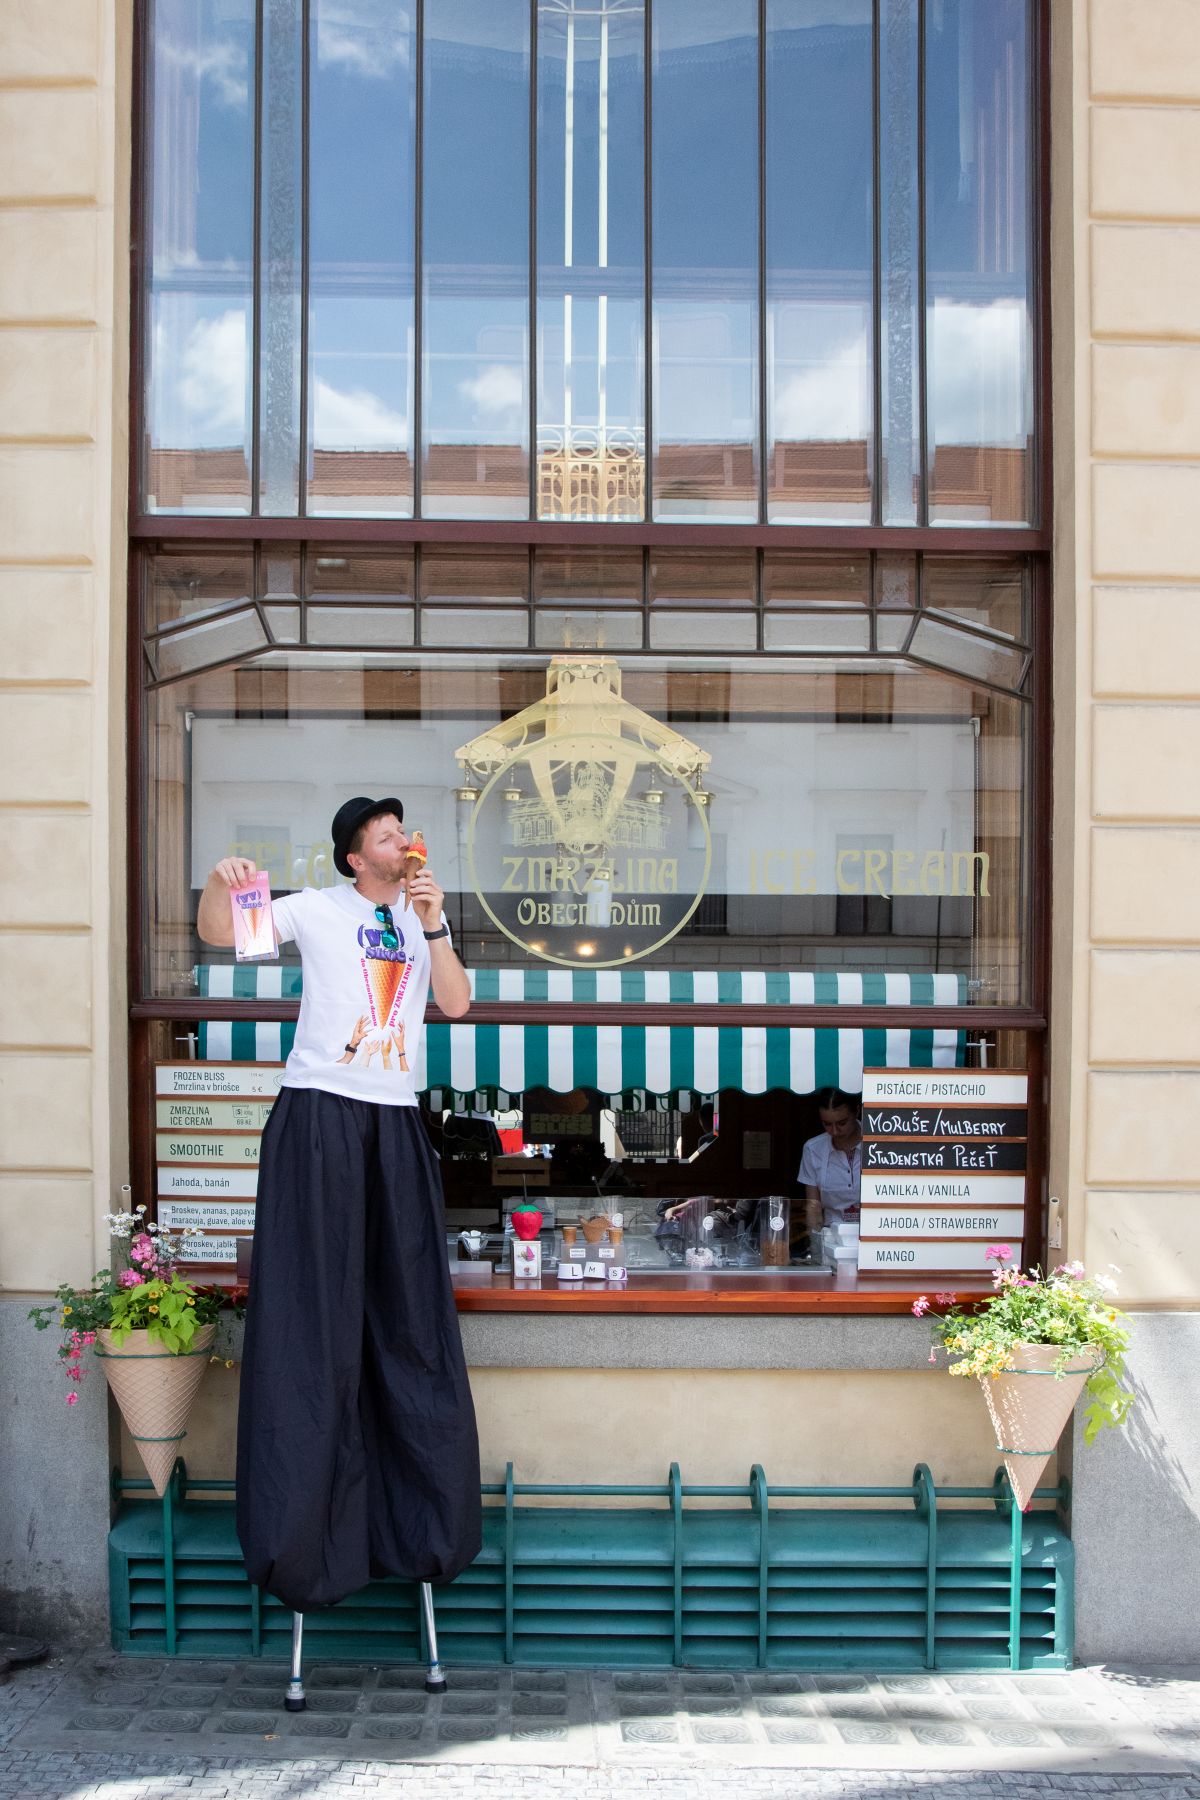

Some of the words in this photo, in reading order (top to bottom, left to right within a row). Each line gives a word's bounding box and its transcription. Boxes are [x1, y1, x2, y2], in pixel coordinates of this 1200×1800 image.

[502, 857, 678, 895] ZMRZLINA
[749, 850, 817, 894] ICE
[836, 850, 990, 899] CREAM
[389, 1010, 398, 1028] pro
[174, 1072, 204, 1081] FROZEN
[205, 1072, 225, 1081] BLISS
[174, 1082, 205, 1091] Zmrzlina
[213, 1083, 240, 1092] briošce
[876, 1081, 922, 1095] PISTÁCIE
[931, 1084, 986, 1096] PISTACHIO
[170, 1106, 209, 1115] ZMRZLINA
[170, 1117, 183, 1126] ICE
[185, 1117, 213, 1126] CREAM
[867, 1110, 930, 1133] MORUŠE
[531, 1121, 593, 1135] BLISS
[170, 1144, 224, 1156] SMOOTHIE
[245, 1148, 258, 1158] 0,4
[952, 1144, 998, 1168] PEČEŤ
[171, 1177, 203, 1189] Jahoda,
[204, 1178, 230, 1187] banán
[875, 1184, 919, 1196] VANILKA
[927, 1185, 971, 1197] VANILLA
[171, 1206, 201, 1215] Broskev,
[202, 1208, 229, 1216] ananas,
[171, 1217, 206, 1226] maracuja,
[207, 1218, 230, 1227] guave,
[231, 1218, 246, 1226] aloe
[877, 1217, 920, 1229] JAHODA
[928, 1217, 999, 1229] STRAWBERRY
[186, 1240, 216, 1249] broskev,
[201, 1250, 224, 1258] modrá
[876, 1250, 915, 1262] MANGO
[571, 1266, 578, 1277] L
[612, 1269, 618, 1277] S
